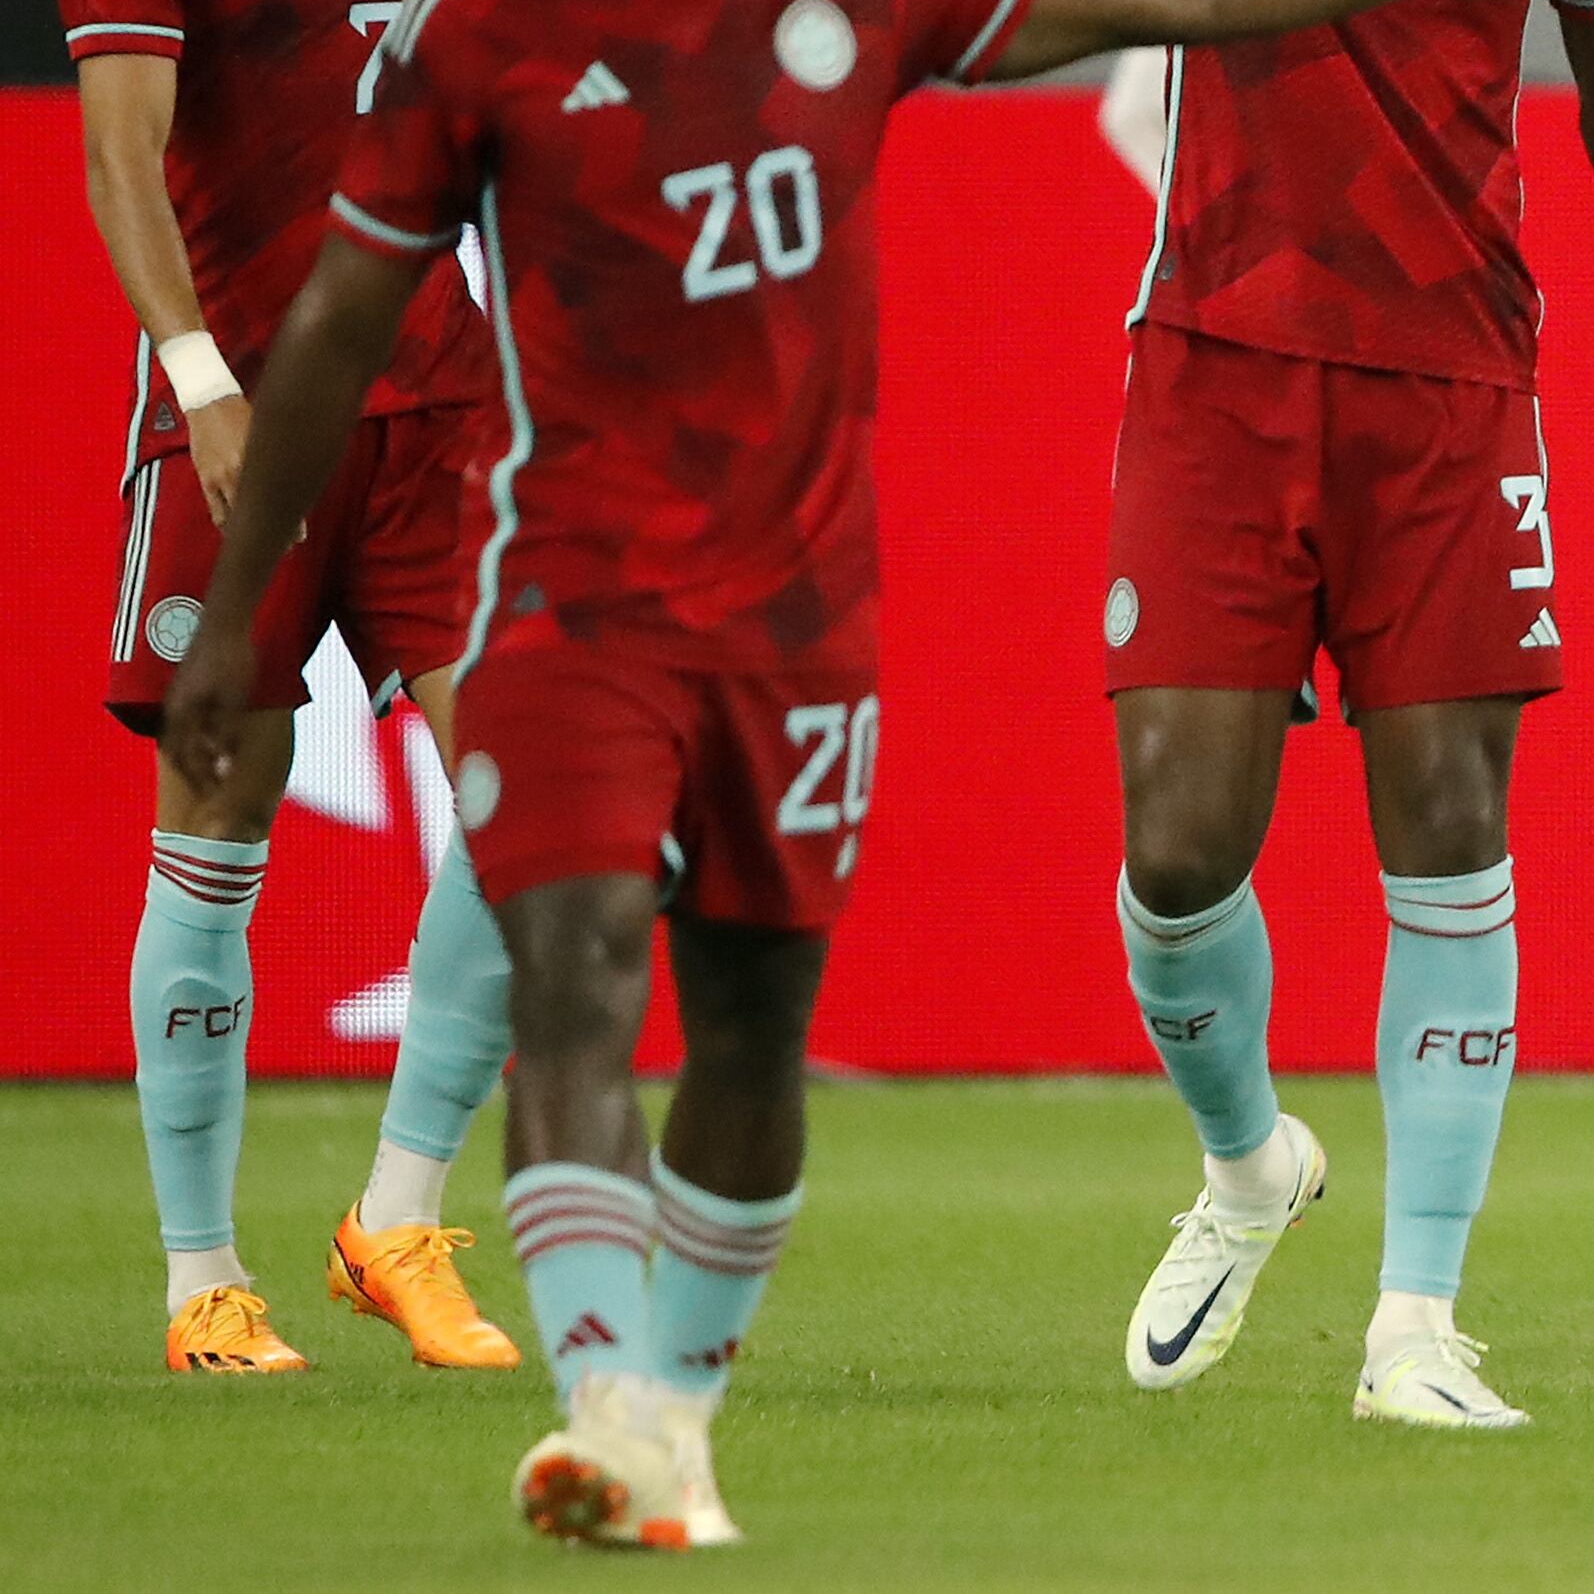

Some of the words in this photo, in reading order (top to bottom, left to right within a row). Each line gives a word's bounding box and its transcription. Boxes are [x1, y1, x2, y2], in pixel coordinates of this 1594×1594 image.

[349, 2, 402, 115] 7
[661, 144, 822, 302] 20
[1501, 475, 1554, 589] 3
[776, 692, 880, 836] 20
[1416, 1025, 1515, 1066] FCF
